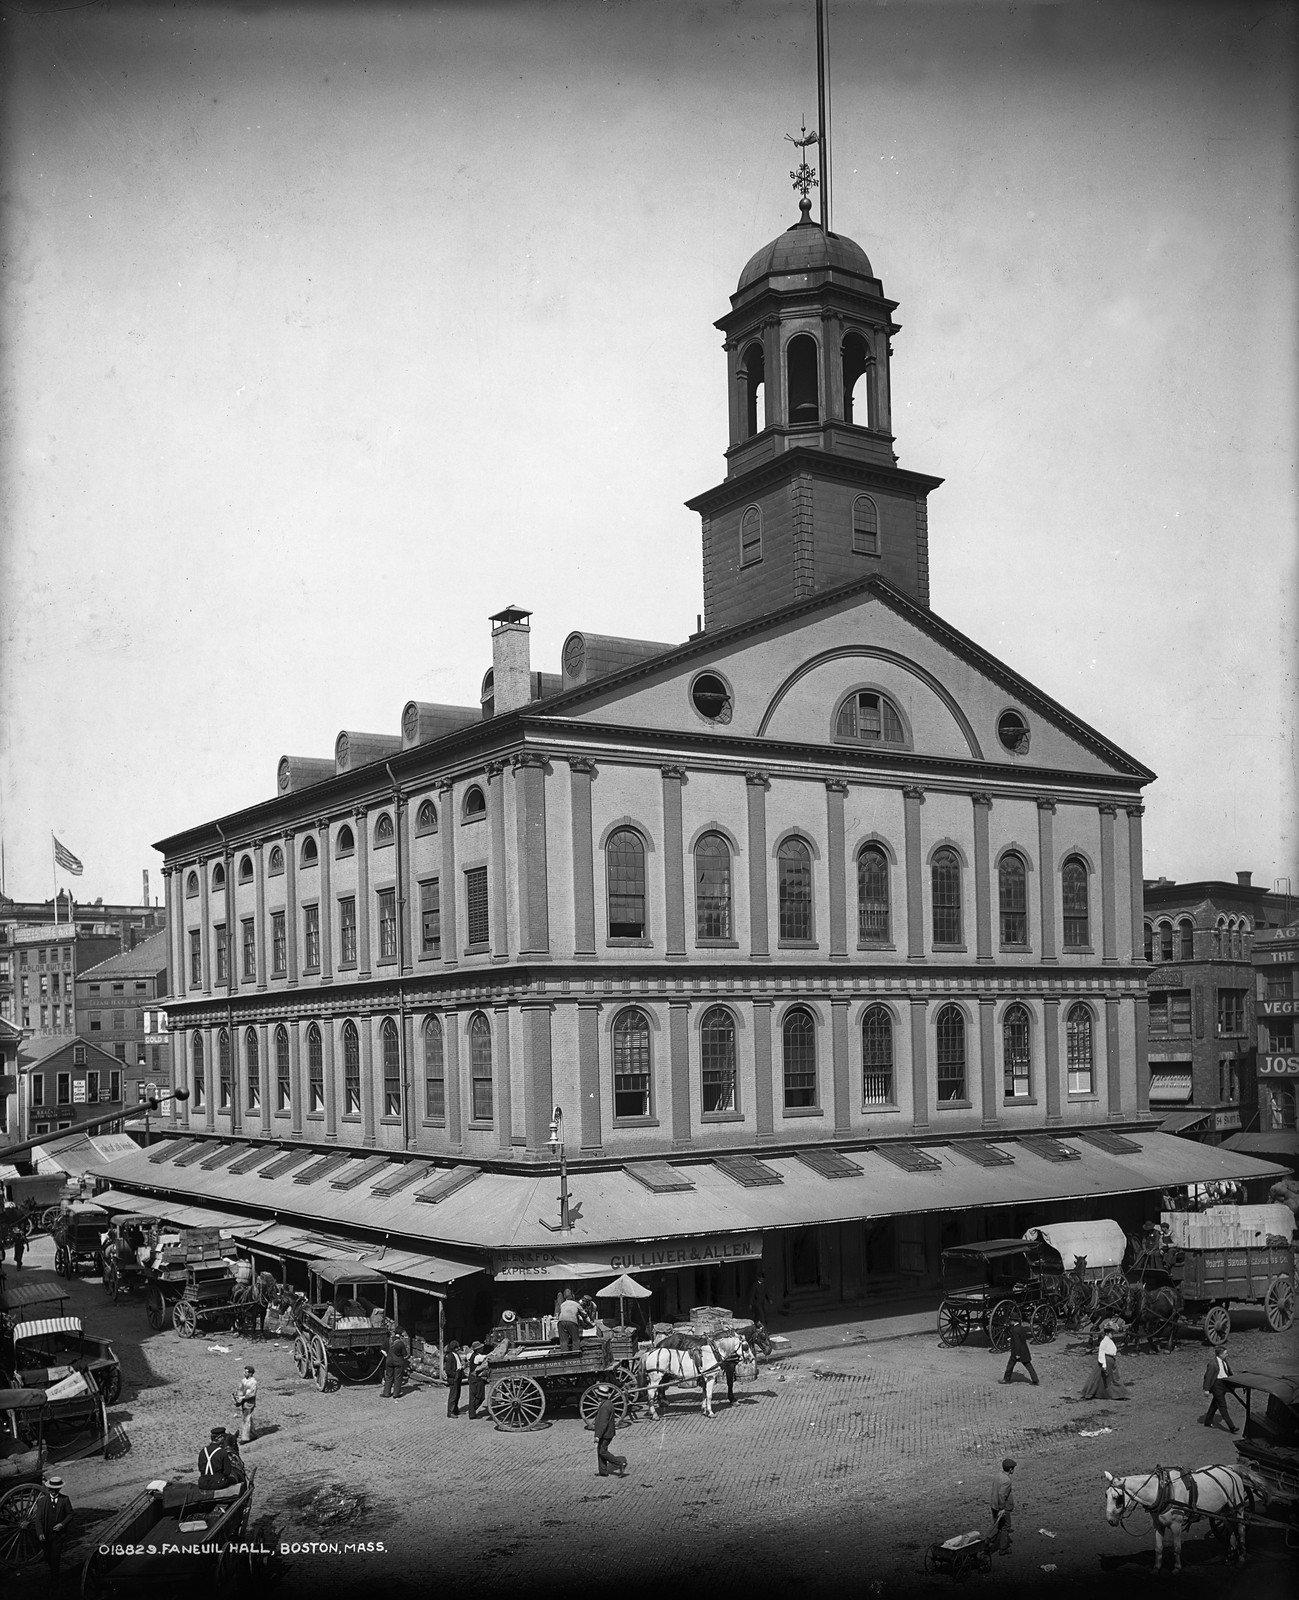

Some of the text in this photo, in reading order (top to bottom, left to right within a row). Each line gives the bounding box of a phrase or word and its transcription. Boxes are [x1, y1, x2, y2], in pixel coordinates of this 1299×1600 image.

[1273, 928, 1299, 940] AG
[1270, 951, 1295, 962] THE
[19, 962, 71, 973] PARLOR SUITES
[498, 1252, 560, 1262] ALLEN & FOX.
[609, 1242, 755, 1270] GULLIVER & ALLEN.
[1205, 1259, 1225, 1268] NORTH
[1227, 1258, 1248, 1267] SHORE
[502, 1266, 551, 1276] EXPRESS.
